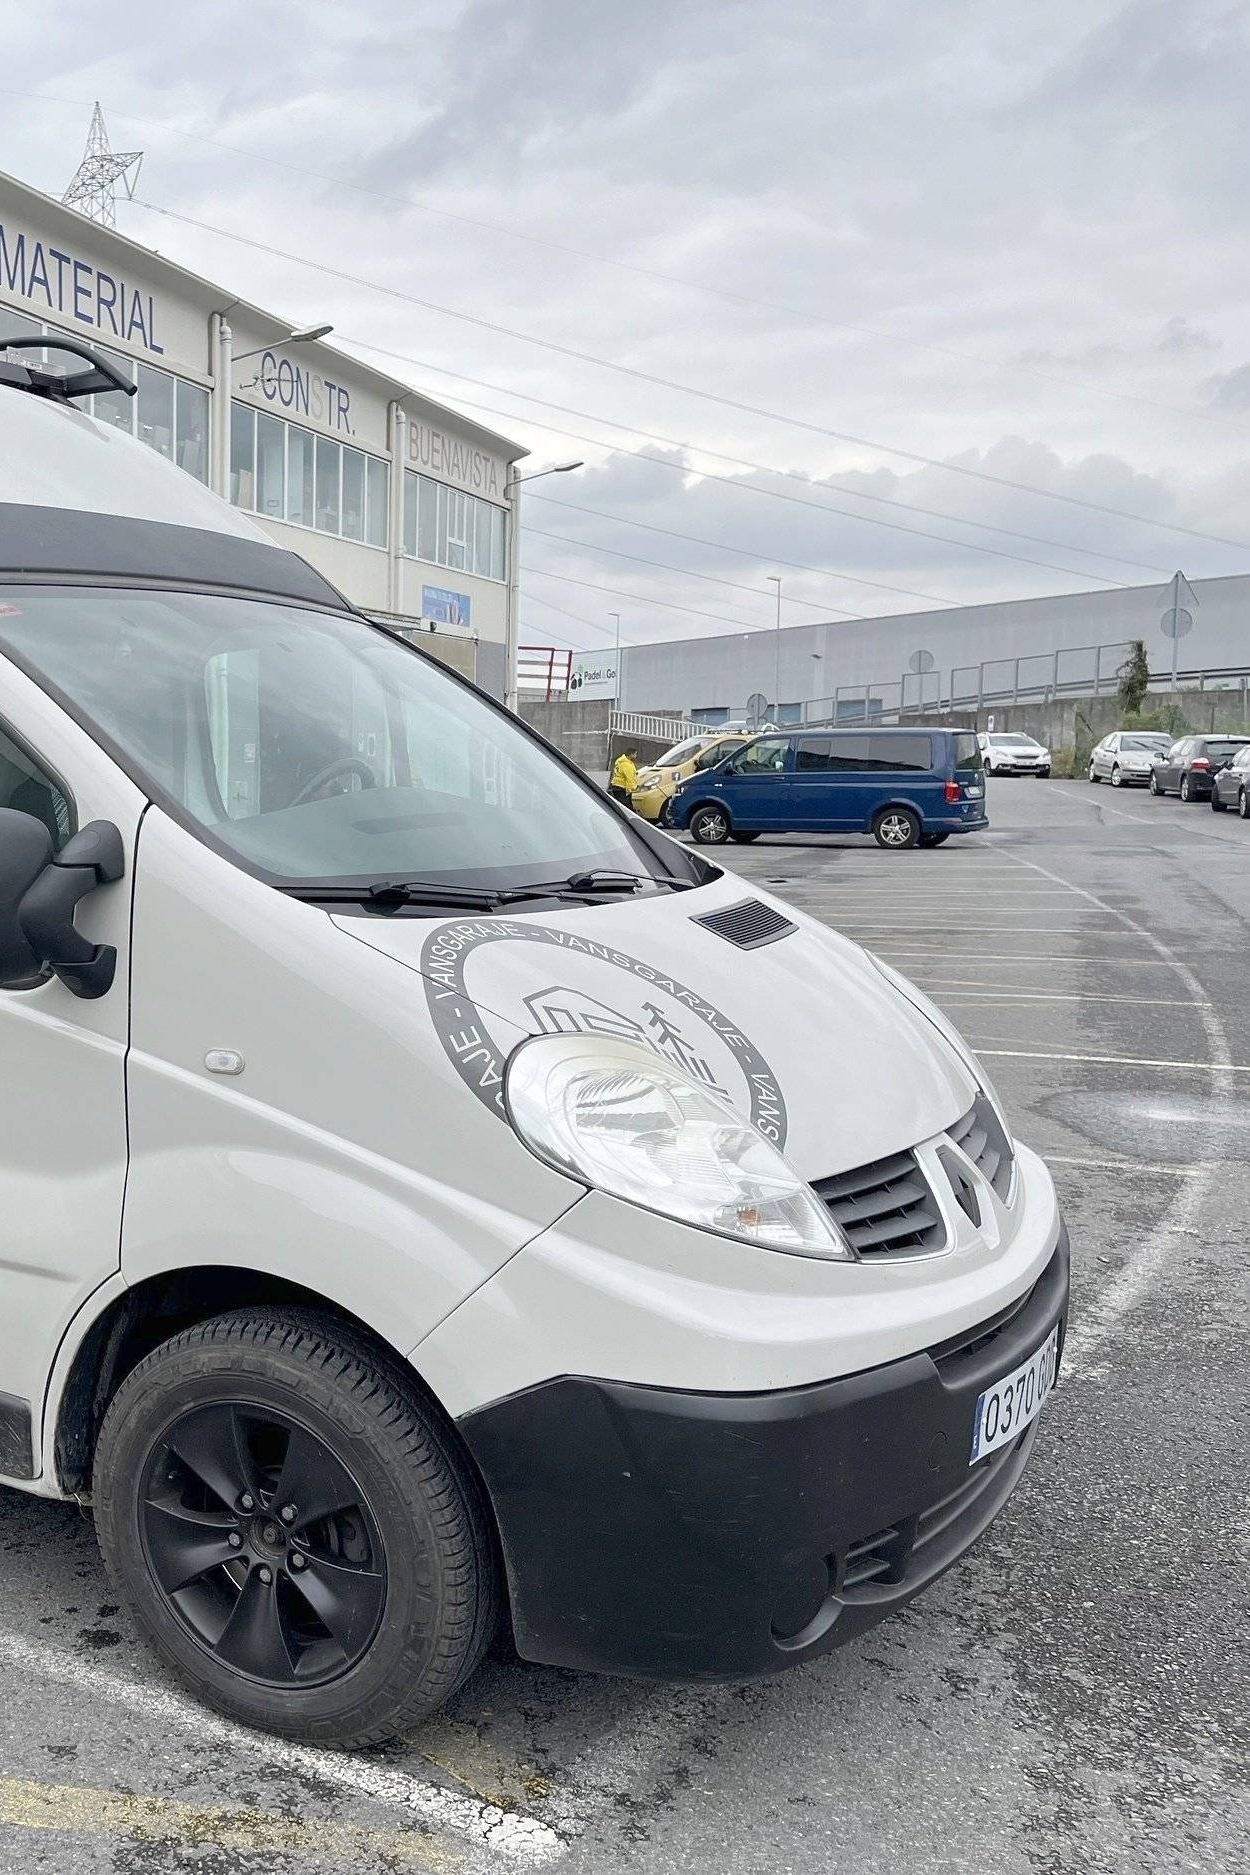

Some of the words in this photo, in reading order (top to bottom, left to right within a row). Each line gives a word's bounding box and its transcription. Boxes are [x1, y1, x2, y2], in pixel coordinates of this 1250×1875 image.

[261, 352, 356, 436] CONSTR.
[409, 420, 498, 496] BUENAVISTA
[584, 670, 602, 680] Padel
[428, 922, 526, 1000] VANSGARAJE
[544, 930, 749, 1048] VANSGARAJE
[751, 1073, 780, 1142] VANS
[985, 1366, 1035, 1443] 0370
